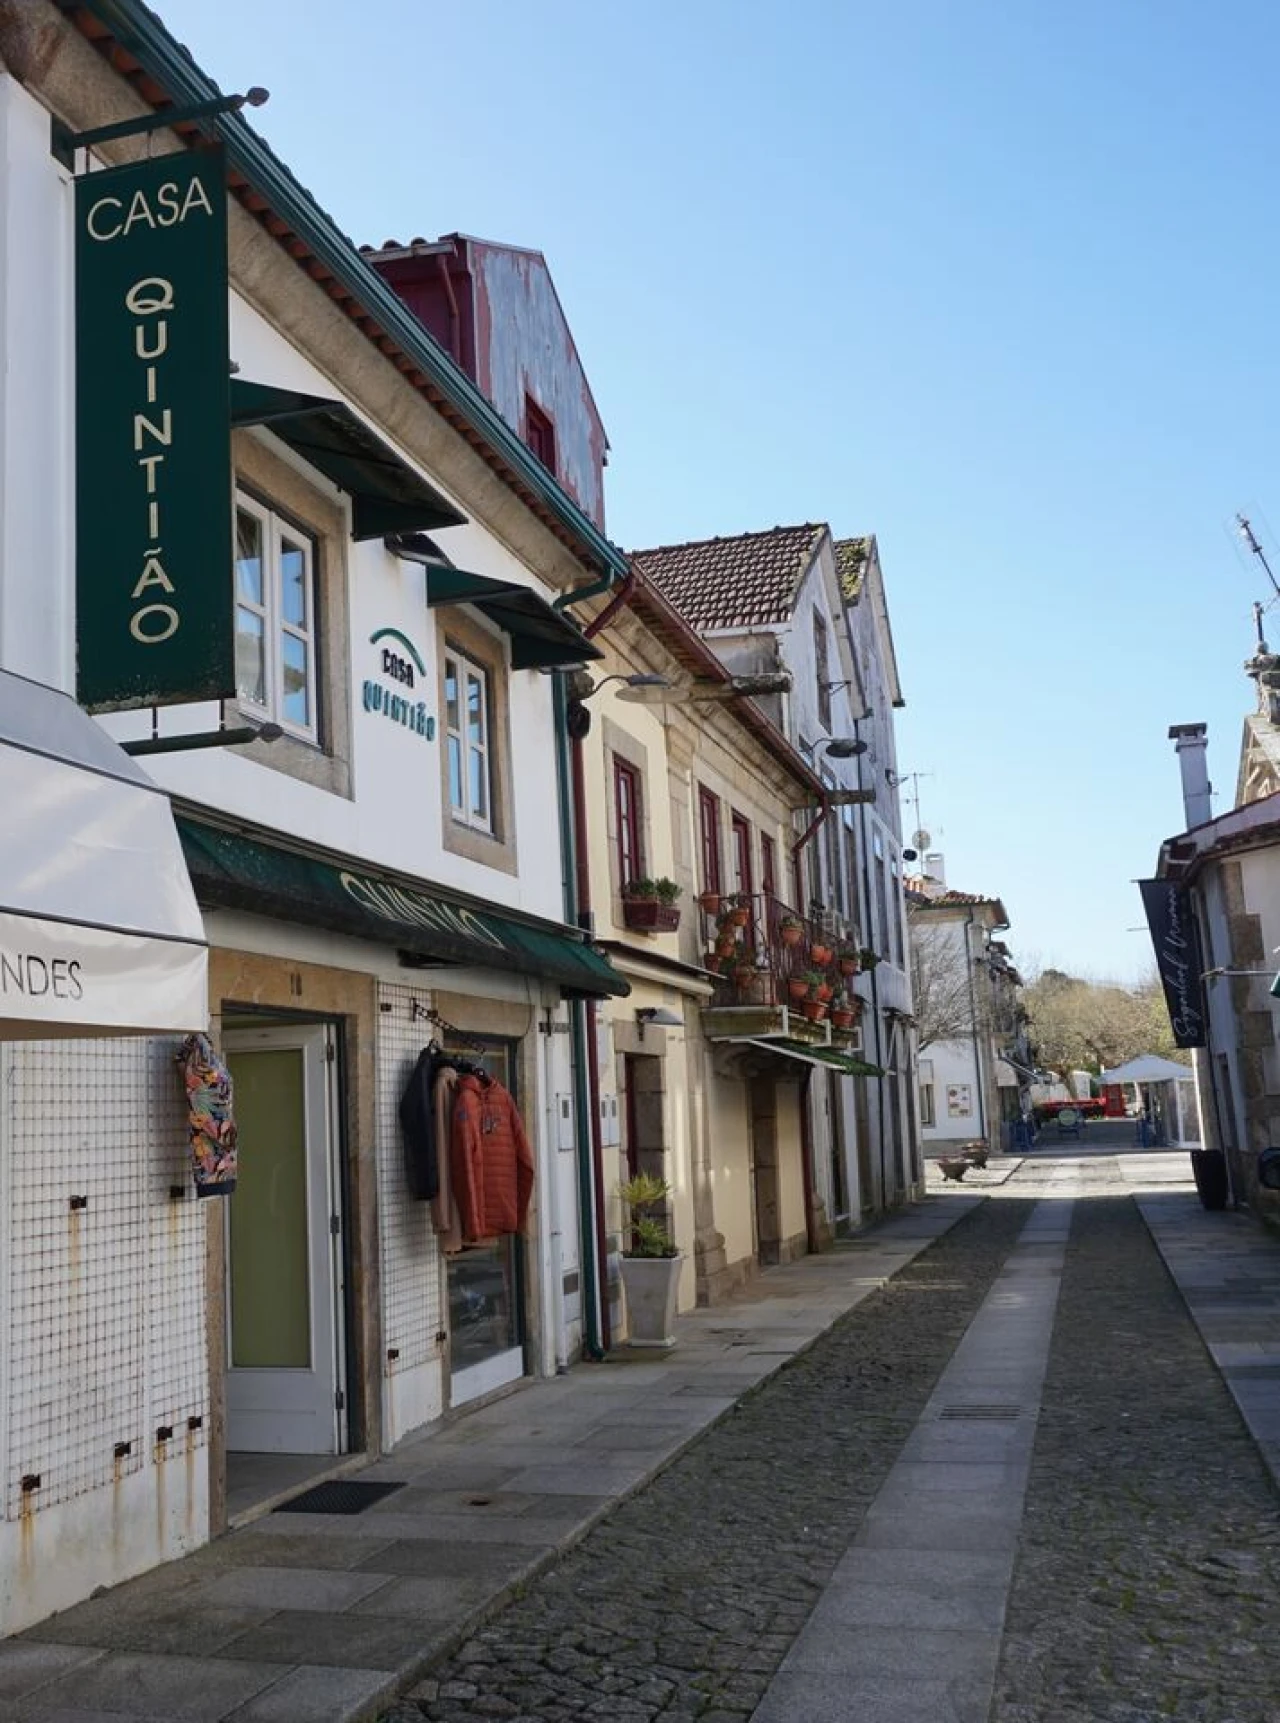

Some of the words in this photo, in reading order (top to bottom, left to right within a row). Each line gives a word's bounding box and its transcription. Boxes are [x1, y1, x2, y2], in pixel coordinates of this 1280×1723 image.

[87, 176, 213, 241] CASA
[125, 276, 180, 643] QUINTIÃO
[381, 648, 414, 689] CASA
[0, 953, 84, 1001] NDES
